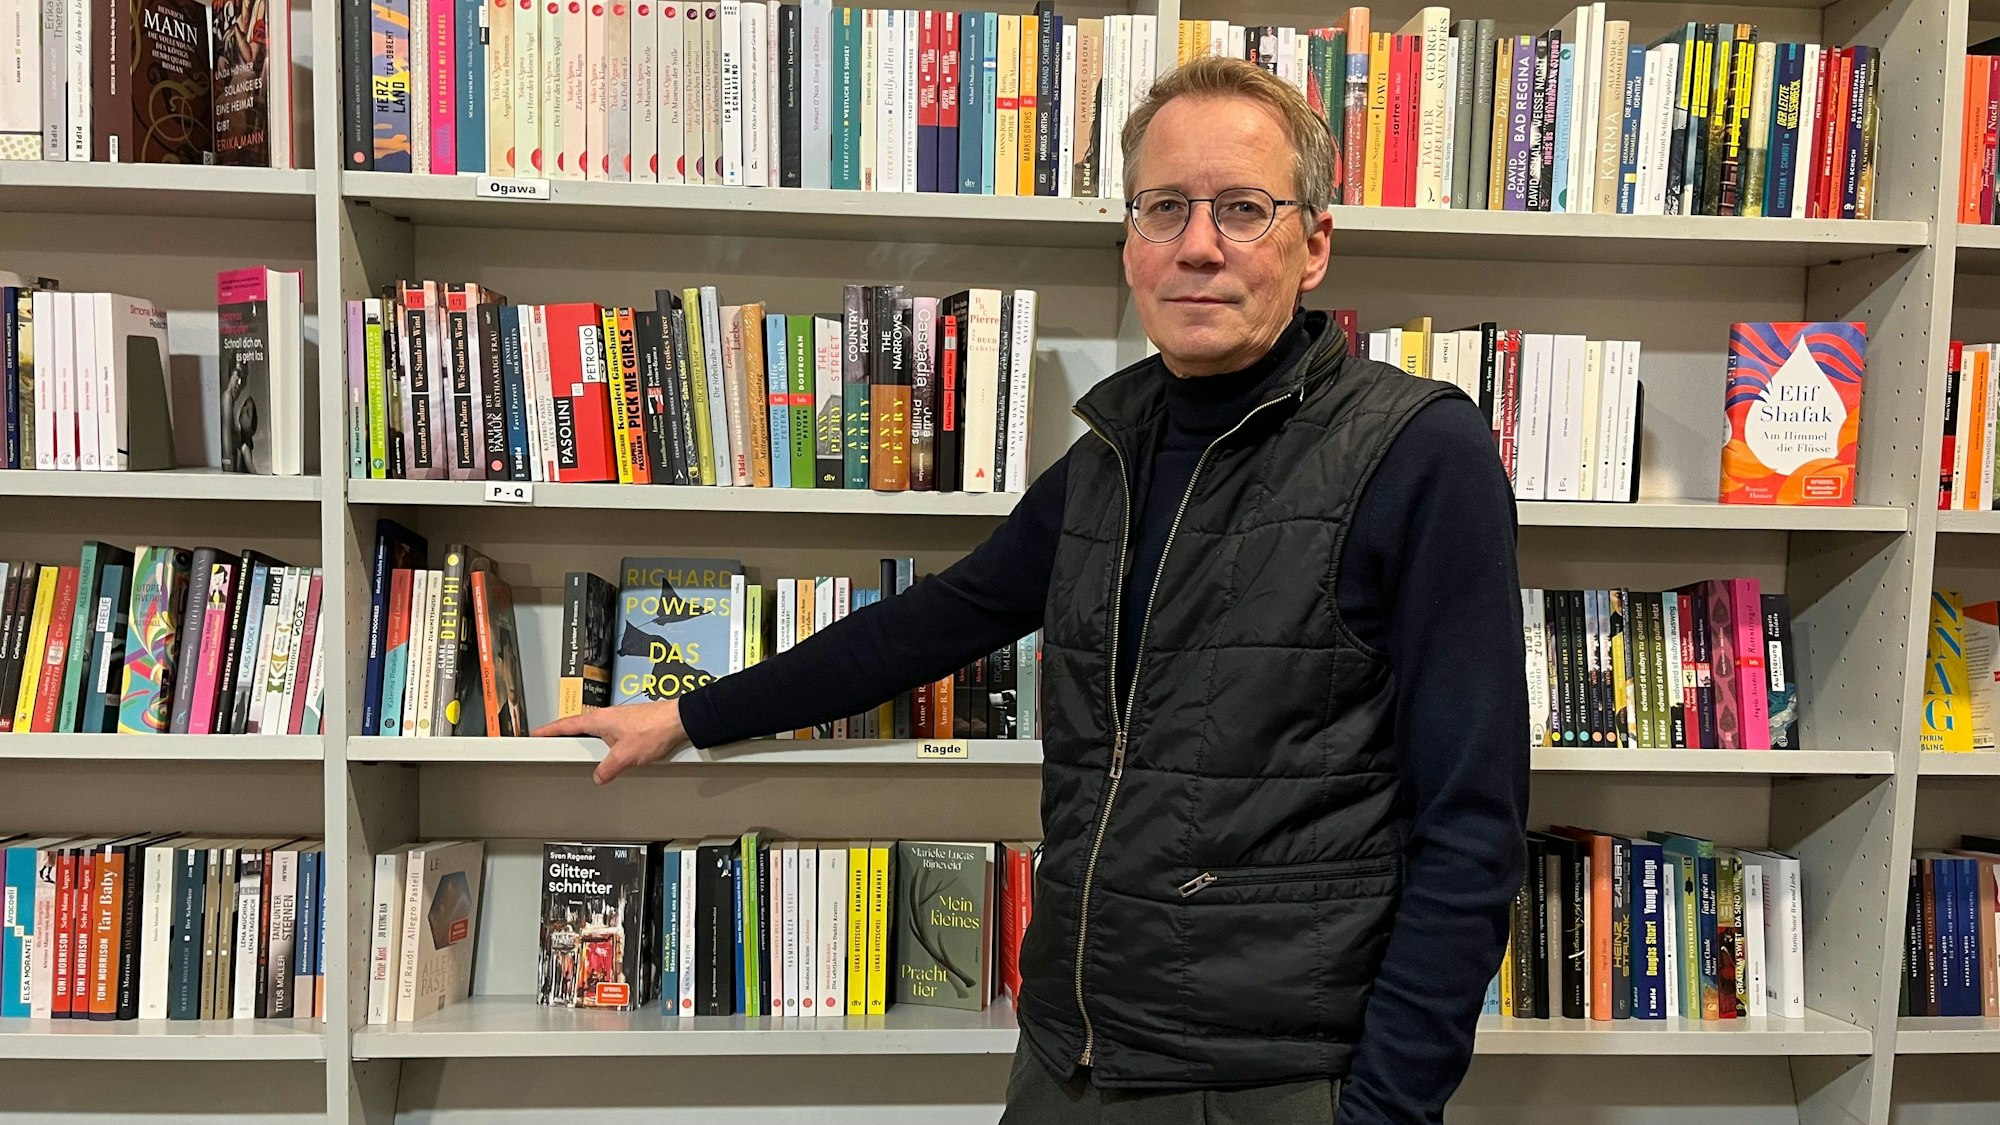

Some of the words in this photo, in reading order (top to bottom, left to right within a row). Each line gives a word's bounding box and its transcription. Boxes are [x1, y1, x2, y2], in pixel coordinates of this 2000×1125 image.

[143, 9, 198, 47] MANN
[1042, 10, 1051, 34] ALLEIN
[386, 30, 394, 59] OBREHT
[1042, 35, 1050, 65] SCHWEBT
[1426, 25, 1437, 81] GEORGE
[1437, 18, 1448, 89] SAUNDERS
[385, 61, 394, 75] TÉA
[885, 47, 895, 75] allein
[1535, 58, 1545, 92] NACHT
[224, 80, 253, 98] SOLANGE
[254, 78, 263, 89] ES
[731, 64, 739, 111] SCHLAFEND
[1041, 66, 1050, 96] NIEMAND
[1371, 72, 1387, 110] Iowa
[1516, 58, 1530, 112] REGINA
[216, 103, 231, 116] EINE
[231, 96, 255, 112] HEIMAT
[376, 81, 389, 112] HERZ
[392, 81, 406, 113] LAND
[1778, 84, 1789, 110] LETZTE
[1788, 79, 1800, 130] HUELSENBECK
[1040, 112, 1049, 133] ORTHS
[1424, 110, 1434, 135] DER
[1532, 93, 1544, 130] WEISSE
[1777, 110, 1787, 127] DER
[1988, 99, 1999, 130] Nackt
[216, 119, 230, 133] GIBT
[1434, 100, 1444, 178] BEFREIUNG
[1514, 115, 1526, 144] BAD
[217, 138, 239, 152] ERIKA
[240, 130, 265, 146] MANN
[1040, 135, 1048, 161] MARKUS
[1422, 140, 1432, 168] TAG
[1601, 114, 1618, 182] KARMA
[1508, 158, 1517, 190] DAVID
[1517, 152, 1527, 201] SCHALKO
[490, 182, 536, 195] Ogawa
[1528, 181, 1539, 209] DAVID
[412, 315, 421, 337] Wind
[660, 315, 669, 339] Feuer
[848, 308, 859, 362] COUNTRY
[860, 318, 868, 353] PLACE
[224, 338, 242, 349] Schnall
[242, 337, 253, 348] dich
[414, 338, 422, 348] im
[490, 330, 499, 352] FRAU
[584, 327, 596, 380] PETROLIO
[608, 326, 620, 380] Gänsehaut
[620, 329, 635, 369] GIRLS
[881, 331, 891, 353] THE
[892, 313, 903, 370] NARROWS
[915, 309, 931, 387] Cascadia
[235, 353, 243, 361] es
[243, 351, 254, 364] geht
[253, 351, 264, 361] los
[414, 349, 423, 371] Staub
[662, 341, 672, 370] Großes
[818, 347, 827, 372] THE
[831, 335, 840, 382] STREET
[415, 372, 424, 388] Wie
[492, 354, 502, 408] ROTHAARIGE
[625, 371, 638, 392] ME
[1780, 385, 1821, 402] Elif
[417, 400, 426, 426] Padura
[485, 393, 493, 408] DIE
[614, 382, 626, 430] Komplett
[628, 394, 641, 428] PICK
[1760, 405, 1833, 423] Shafak
[486, 413, 494, 452] ORHAN
[493, 413, 504, 452] PAMUK
[558, 400, 574, 464] PASOLINI
[880, 413, 890, 450] ANN
[893, 398, 903, 465] PETRY
[911, 399, 922, 445] Phillips
[922, 406, 932, 437] Julia
[418, 427, 428, 463] Leonardo
[1760, 431, 1780, 441] Am
[1783, 431, 1828, 441] Himmel
[1776, 444, 1793, 453] die
[1797, 443, 1831, 454] Flüsse
[493, 487, 502, 497] P
[514, 488, 524, 499] Q
[82, 559, 92, 585] HABEN
[626, 568, 732, 588] RICHARD
[79, 586, 88, 609] ALLES
[270, 576, 281, 604] PIPER
[98, 598, 111, 630] TREUE
[440, 577, 460, 640] DELPHI
[625, 596, 731, 617] POWERS
[1637, 619, 1645, 640] guter
[1669, 606, 1679, 636] ausweg
[437, 643, 446, 669] CLARE
[649, 641, 700, 664] DAS
[1639, 641, 1645, 651] zu
[445, 643, 456, 680] POLLARD
[1639, 652, 1648, 675] aubyn
[1771, 644, 1780, 688] Aufklärung
[619, 673, 719, 700] GROSS
[1641, 675, 1647, 683] st
[1641, 683, 1649, 712] edward
[924, 744, 961, 755] Ragde
[550, 851, 566, 860] Sven
[567, 853, 596, 862] Regener
[911, 847, 946, 859] Marieke
[948, 849, 975, 860] Lucas
[923, 858, 963, 871] Rijneveld
[549, 863, 601, 879] Glitter-
[1614, 844, 1623, 908] ZAUBER
[1643, 859, 1657, 888] Mungo
[1733, 877, 1741, 893] WIR
[99, 869, 118, 905] Baby
[409, 872, 419, 903] Pastell
[548, 879, 613, 895] schnitter
[7, 889, 16, 924] Aracoeli
[273, 895, 282, 920] UNTER
[939, 894, 973, 912] Mein
[1643, 889, 1658, 914] Young
[98, 909, 112, 933] Tar
[272, 922, 281, 941] TANZ
[282, 895, 294, 941] STERNEN
[407, 906, 417, 940] Allegro
[931, 909, 980, 929] kleines
[1734, 915, 1742, 928] DA
[1614, 920, 1622, 968] HEINZ
[1622, 913, 1630, 977] STRUNK
[1645, 921, 1657, 945] Stuart
[1734, 932, 1743, 957] SWIFT
[24, 938, 32, 978] MORANTE
[97, 938, 108, 980] MORRISON
[276, 955, 285, 988] MÜLLER
[404, 949, 415, 977] Randt
[1645, 946, 1659, 976] Douglas
[901, 964, 948, 982] Pracht
[1735, 957, 1744, 995] GRAHAM
[23, 979, 31, 1001] ELSA
[97, 983, 106, 1001] TONI
[275, 989, 284, 1013] TITUS
[403, 979, 412, 998] Leif
[912, 981, 938, 998] tier
